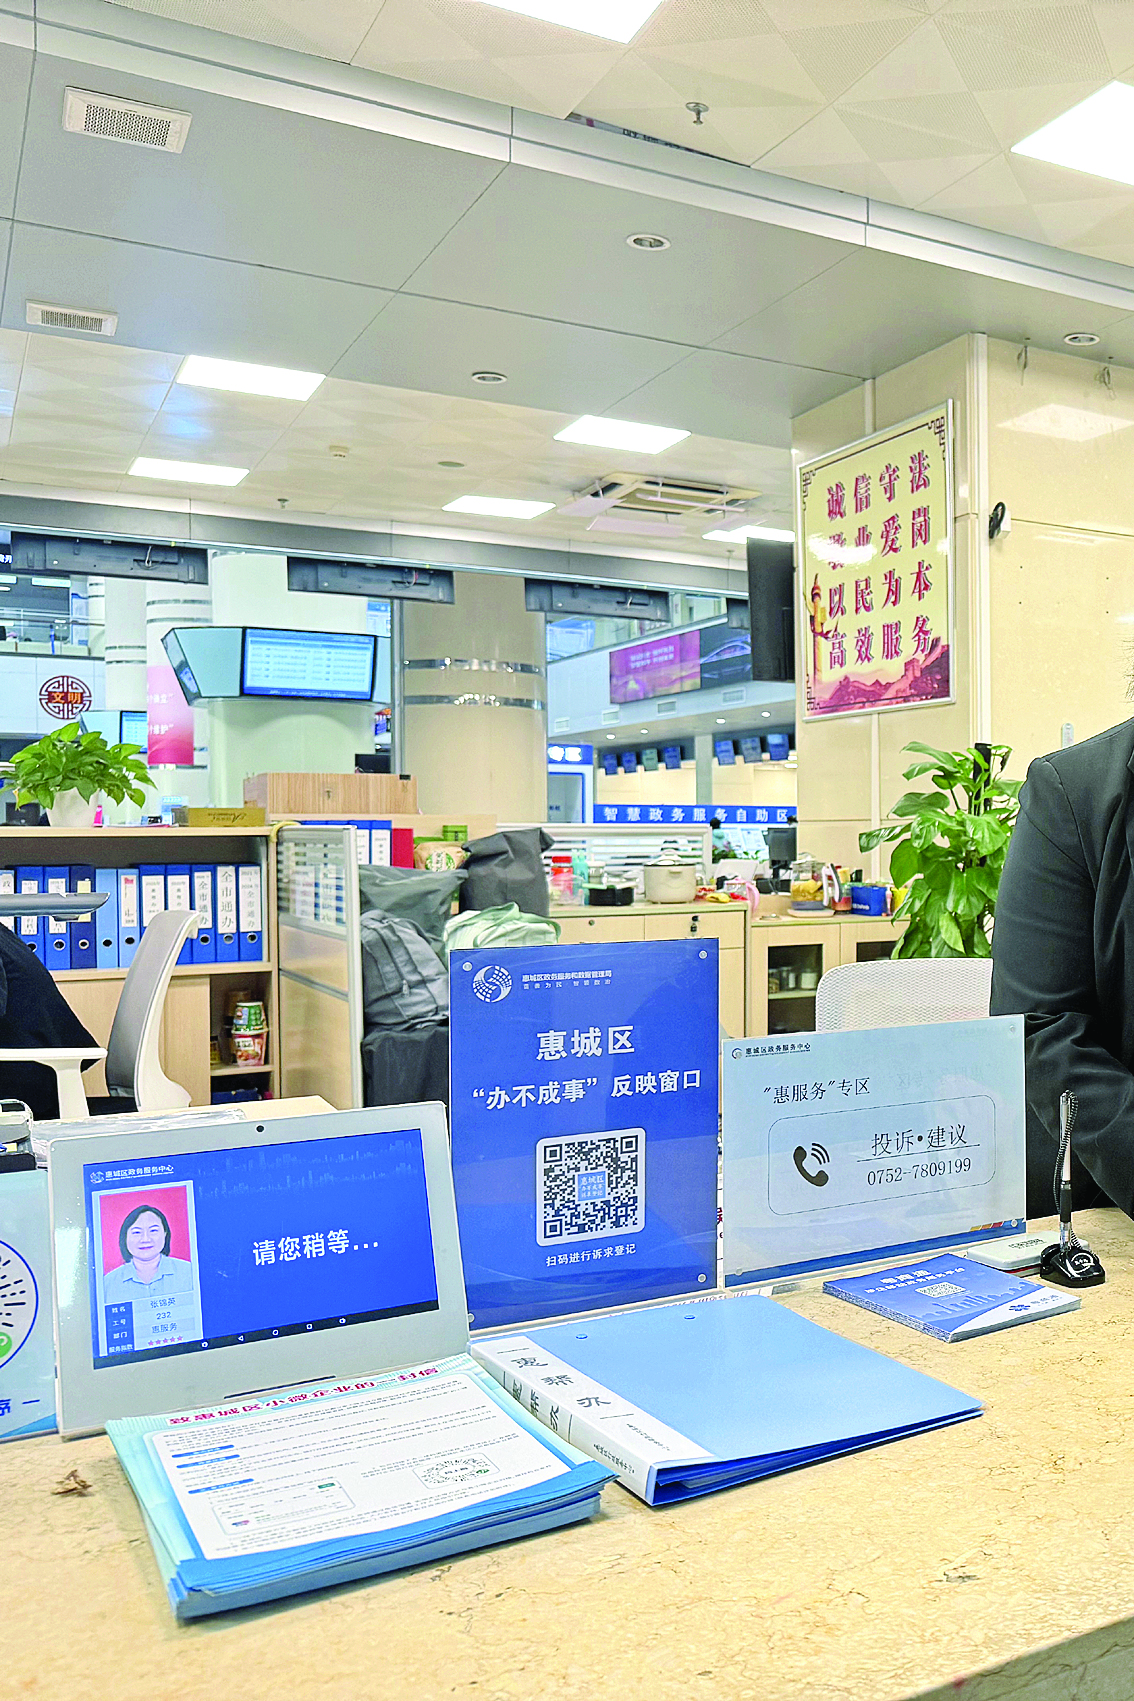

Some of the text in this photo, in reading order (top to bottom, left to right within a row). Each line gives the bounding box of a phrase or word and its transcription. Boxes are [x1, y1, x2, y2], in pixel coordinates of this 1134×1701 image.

[826, 449, 930, 522] 诚信守法
[828, 560, 933, 620] 以民为本
[828, 615, 933, 670] 高效服务
[50, 691, 83, 704] 文明
[604, 807, 788, 823] 智慧政务服务自助区
[221, 871, 234, 928] 全市通办
[536, 1026, 635, 1061] 惠城区
[745, 1042, 811, 1054] 惠城区政务服务中心
[472, 1069, 702, 1111] “办不成事” 反映窗口
[105, 1164, 174, 1178] 惠城区政务服务中心
[867, 1157, 972, 1187] 0752-7809199
[252, 1229, 379, 1267] 请您稍等...
[545, 1243, 637, 1267] 扫码进行诉求登记
[112, 1306, 126, 1314] 姓名
[112, 1311, 171, 1327] 工号 232
[113, 1323, 177, 1339] 部门 惠服务
[169, 1366, 439, 1426] 致惠城区小微企业的一封信
